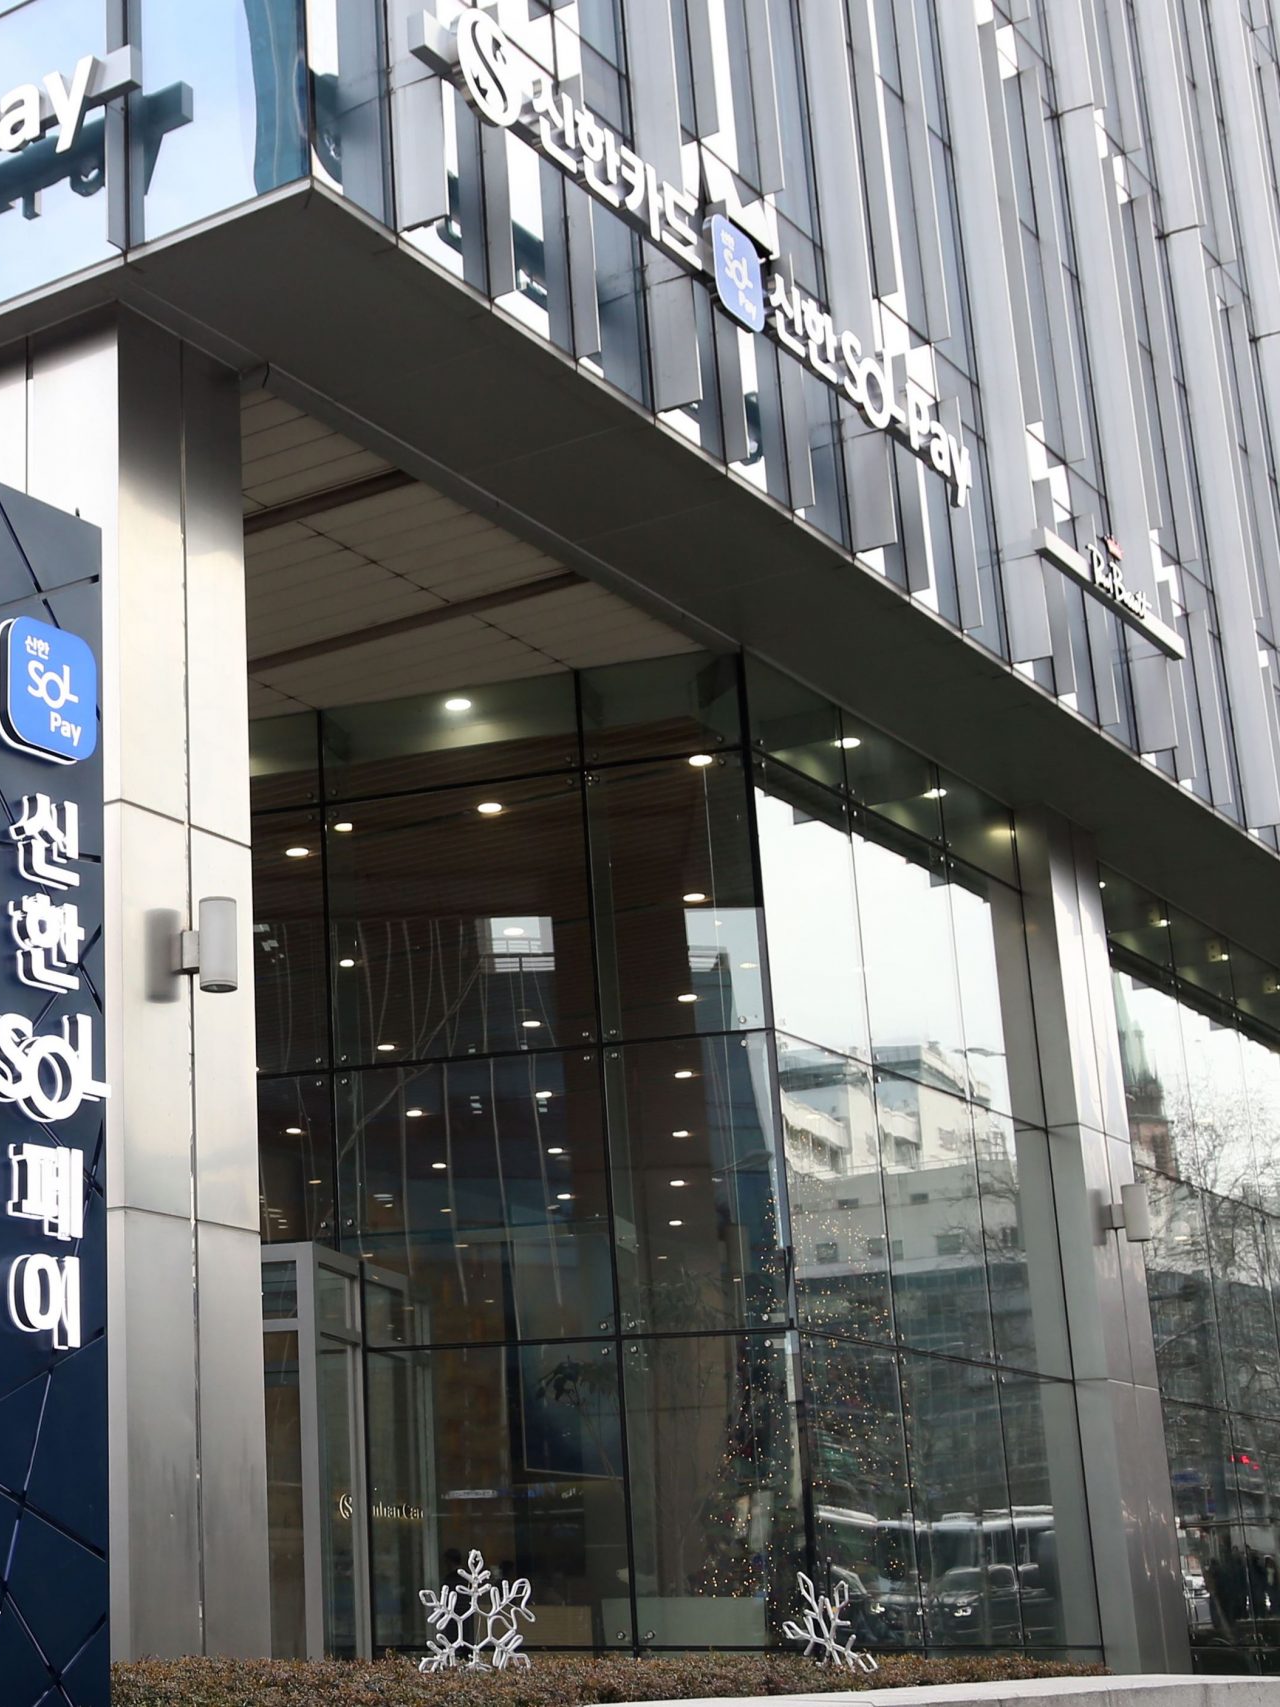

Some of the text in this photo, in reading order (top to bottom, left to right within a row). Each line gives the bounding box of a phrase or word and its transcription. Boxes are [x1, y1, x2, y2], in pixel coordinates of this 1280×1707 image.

[532, 79, 703, 271] 신한카드
[770, 272, 971, 508] 신한 SOL Pay
[25, 635, 50, 660] 신한
[27, 660, 79, 709] SOL
[50, 711, 82, 747] Pay
